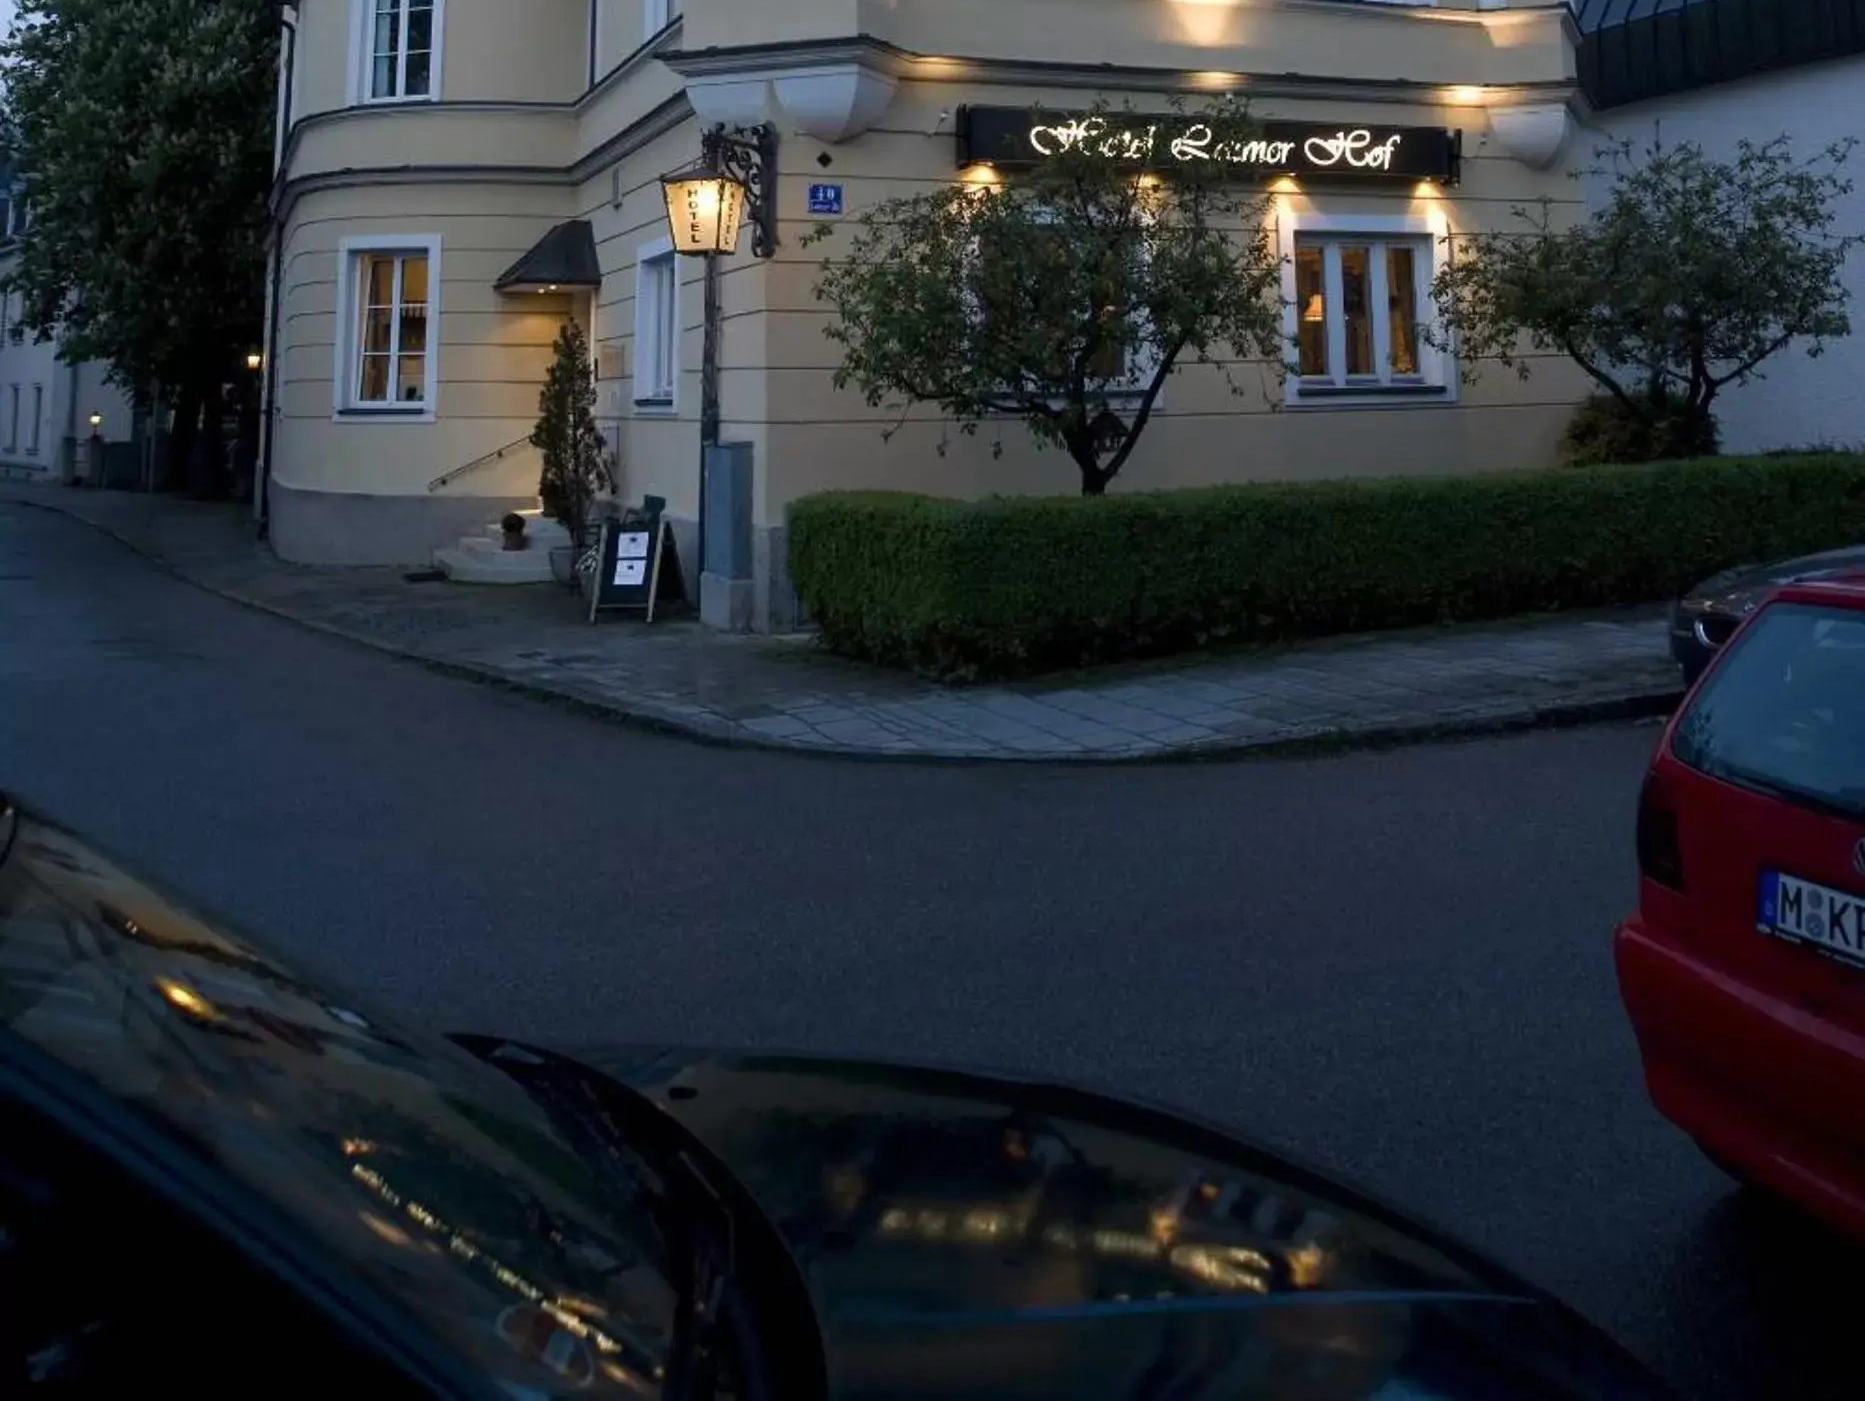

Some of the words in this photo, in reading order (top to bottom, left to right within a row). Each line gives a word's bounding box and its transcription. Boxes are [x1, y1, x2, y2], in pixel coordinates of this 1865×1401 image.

[1303, 129, 1401, 170] Hof
[687, 189, 701, 243] HOTEL
[1781, 882, 1803, 930] M
